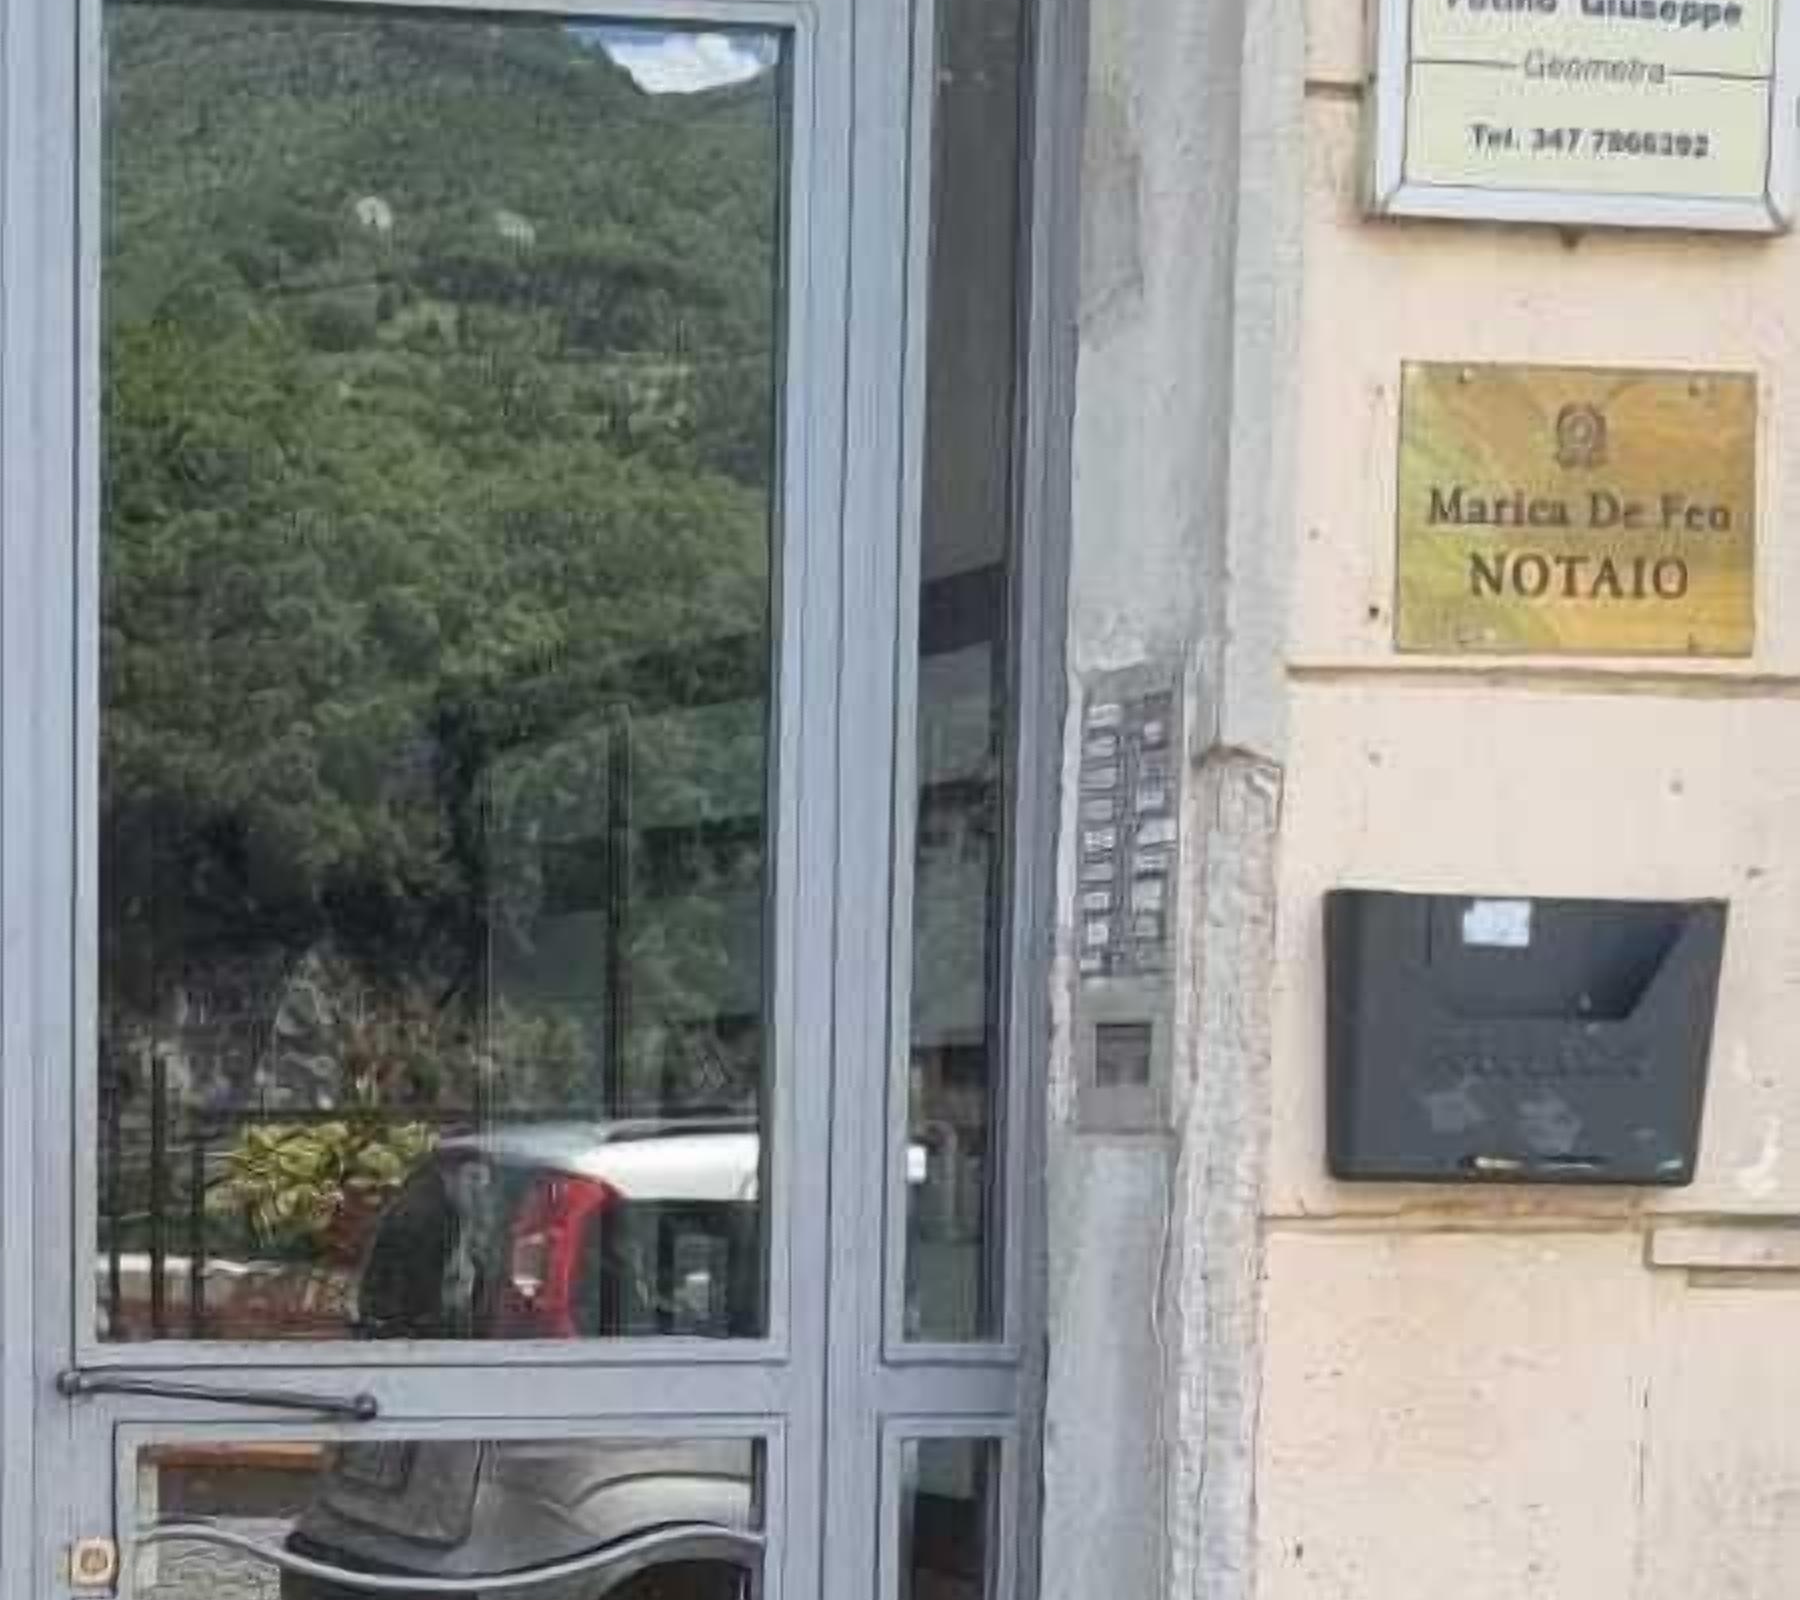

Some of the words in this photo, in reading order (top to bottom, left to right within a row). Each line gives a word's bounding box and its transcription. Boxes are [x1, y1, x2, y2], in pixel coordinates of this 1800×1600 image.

[1524, 50, 1666, 85] Geometra
[1471, 124, 1522, 152] Tel.
[1427, 486, 1570, 527] Marica
[1587, 489, 1649, 531] De
[1659, 492, 1732, 532] Feo
[1467, 552, 1690, 600] NOTAIO
